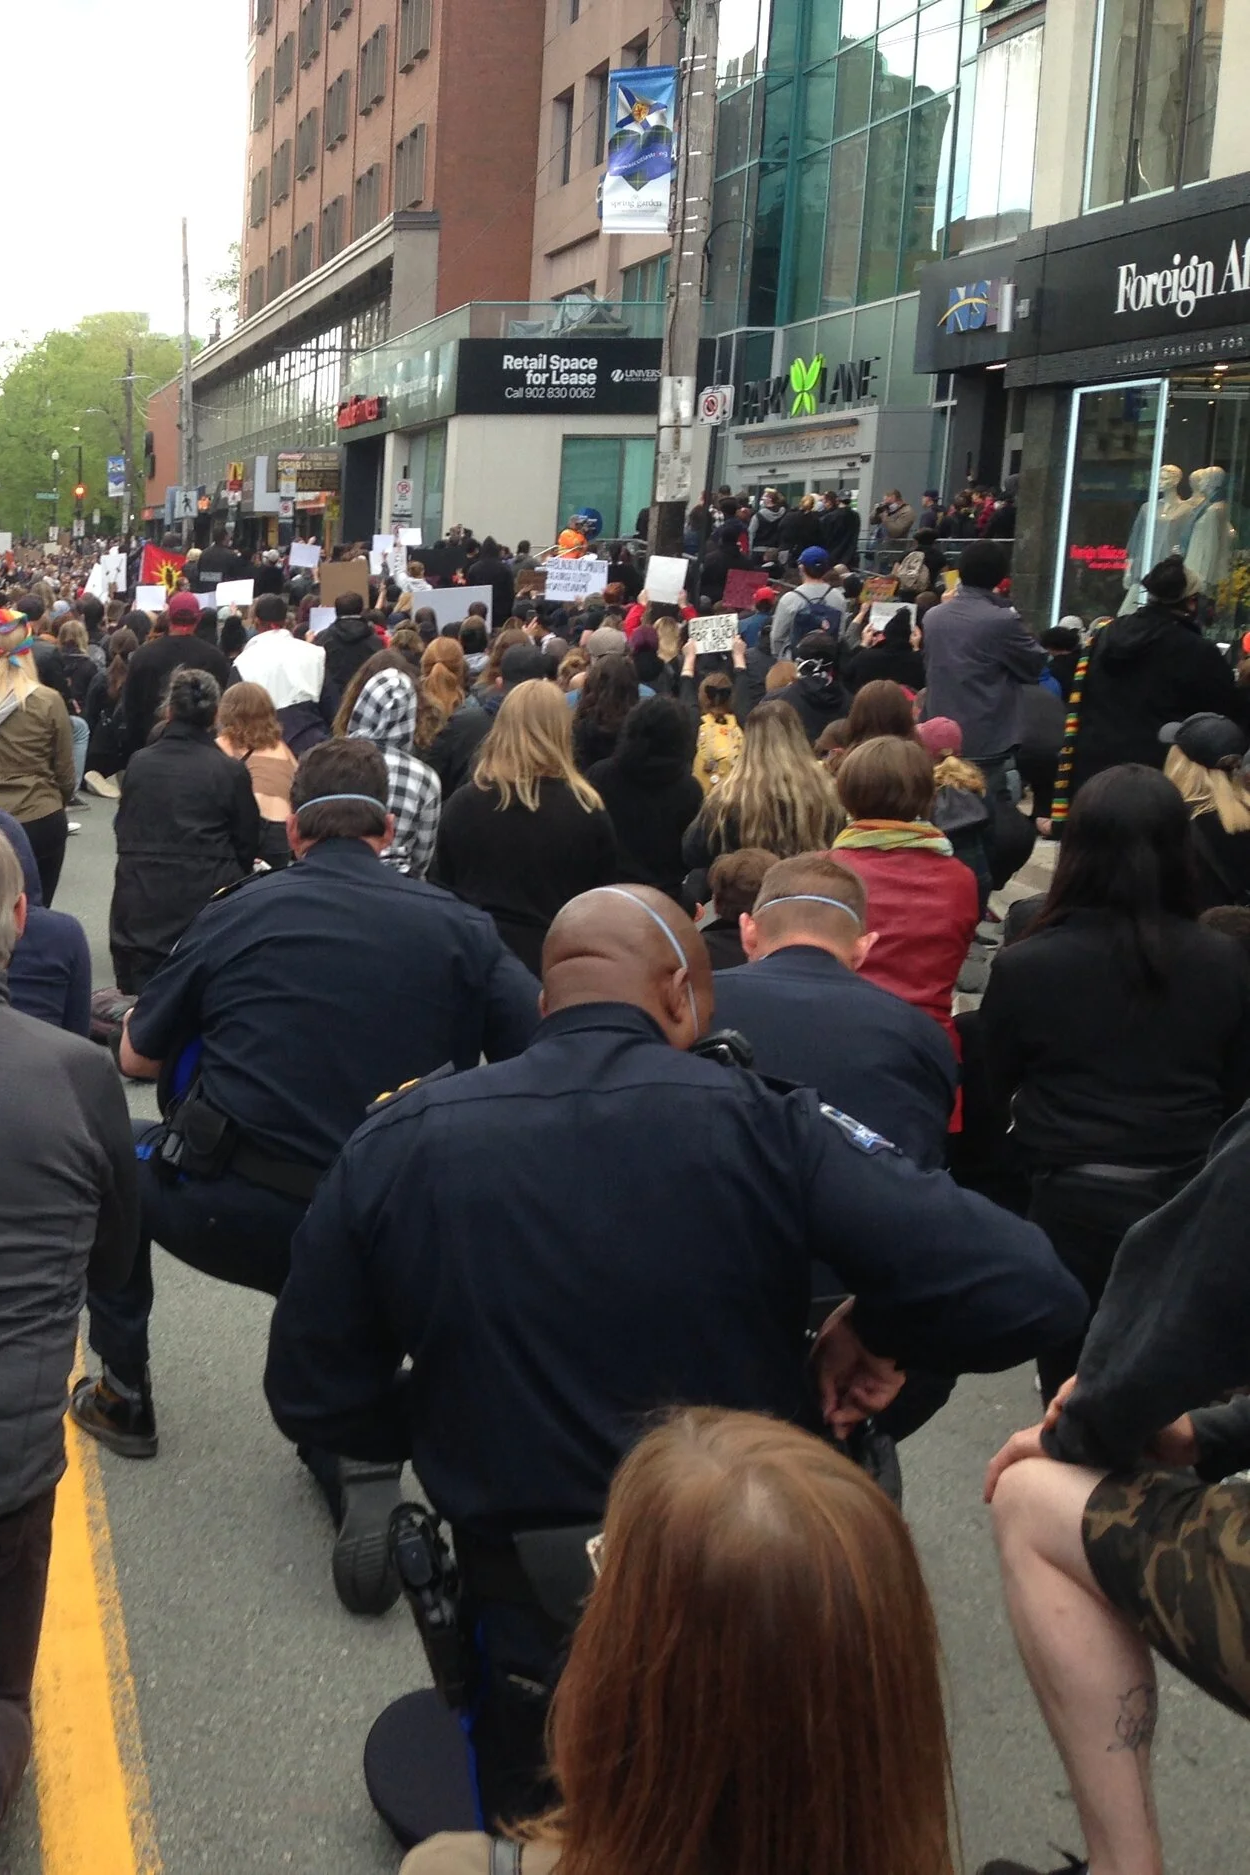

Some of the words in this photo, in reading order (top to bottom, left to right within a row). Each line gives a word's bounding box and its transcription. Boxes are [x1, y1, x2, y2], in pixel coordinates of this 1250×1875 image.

[1114, 253, 1215, 318] Foreign
[1163, 342, 1214, 357] FASHION
[1221, 337, 1244, 349] FOR
[502, 354, 547, 369] Retail
[549, 355, 598, 372] Space
[526, 370, 549, 385] for
[551, 371, 597, 385] Lease
[505, 387, 524, 398] Call
[525, 388, 545, 398] 902
[547, 388, 567, 399] 830
[569, 388, 596, 398] 0062
[278, 461, 312, 470] SPORTS
